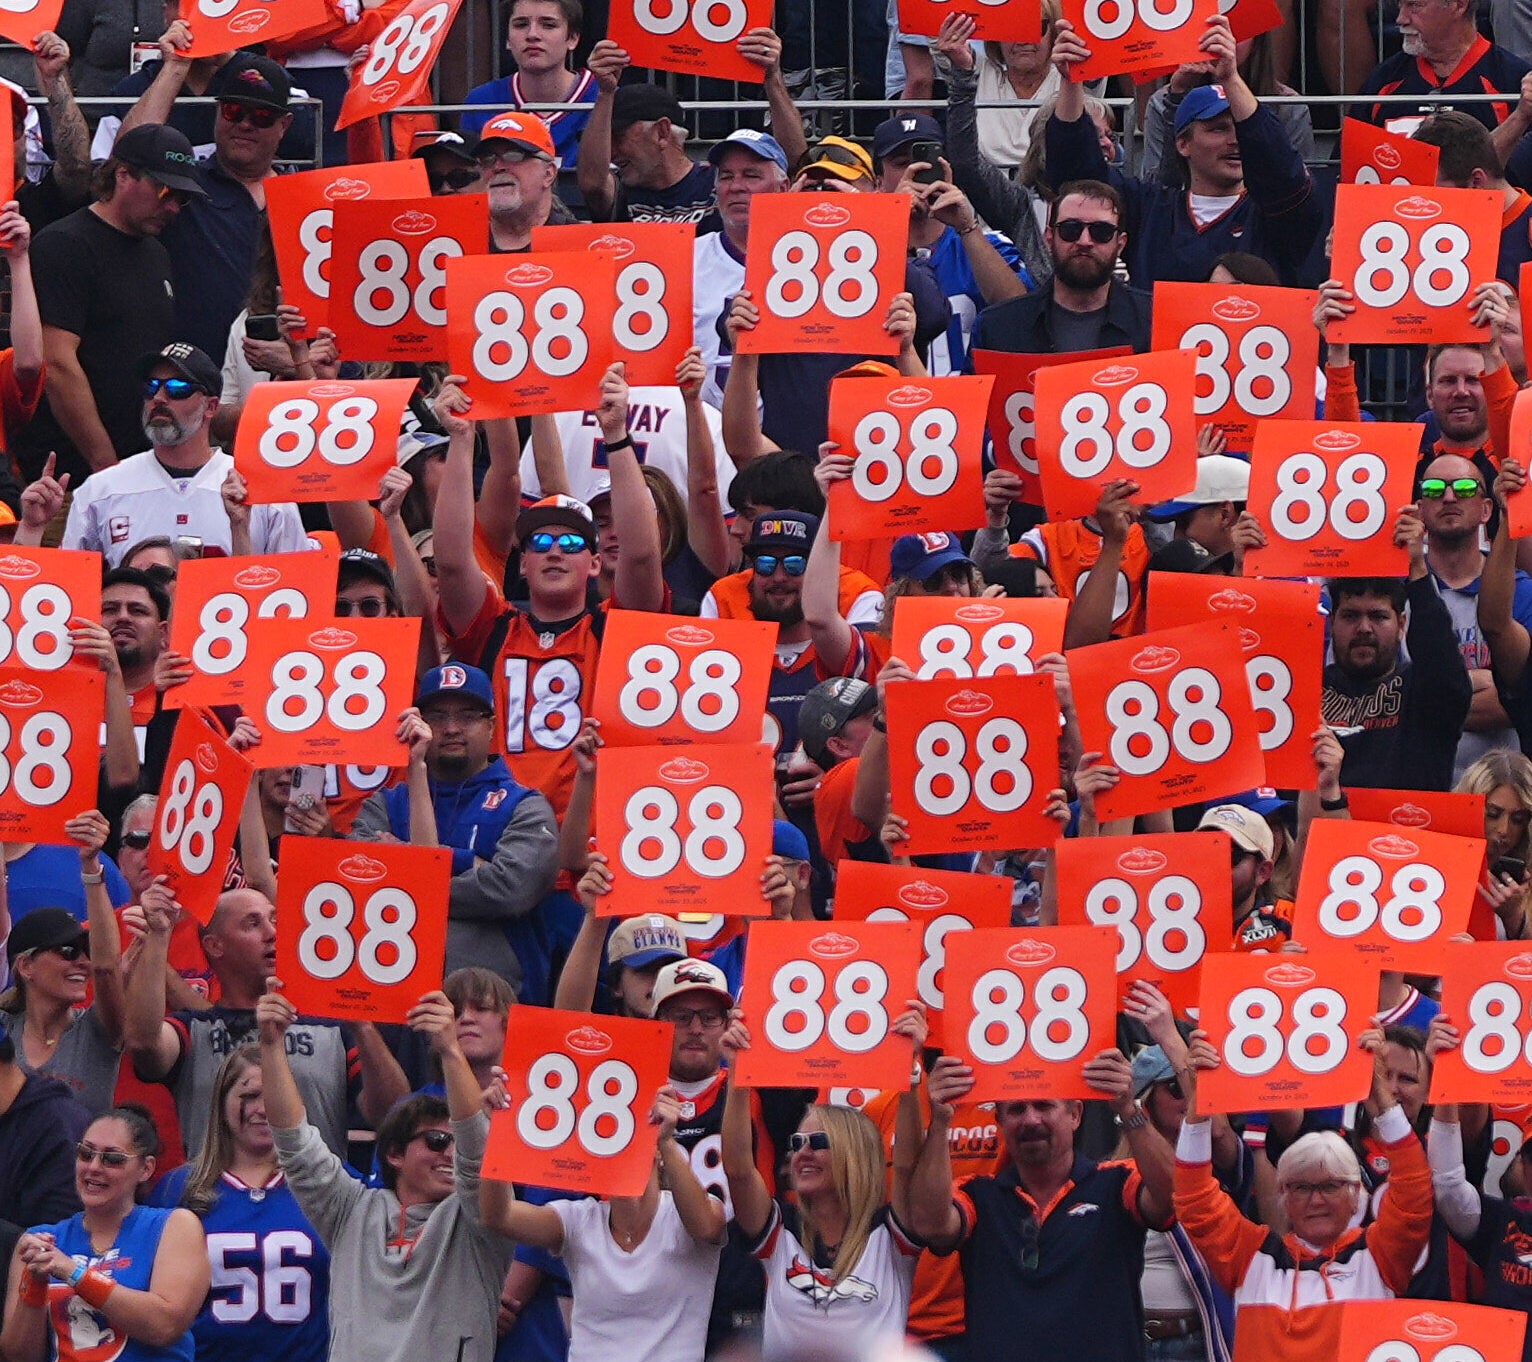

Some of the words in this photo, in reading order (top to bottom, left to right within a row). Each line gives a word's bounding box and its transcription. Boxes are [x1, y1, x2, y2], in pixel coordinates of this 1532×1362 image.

[765, 230, 878, 318] 88
[582, 406, 671, 433] EWAY
[265, 651, 386, 732] 88
[504, 658, 582, 751] 18
[1318, 856, 1445, 942] 88
[764, 960, 888, 1052] 88
[208, 1230, 312, 1325] 56
